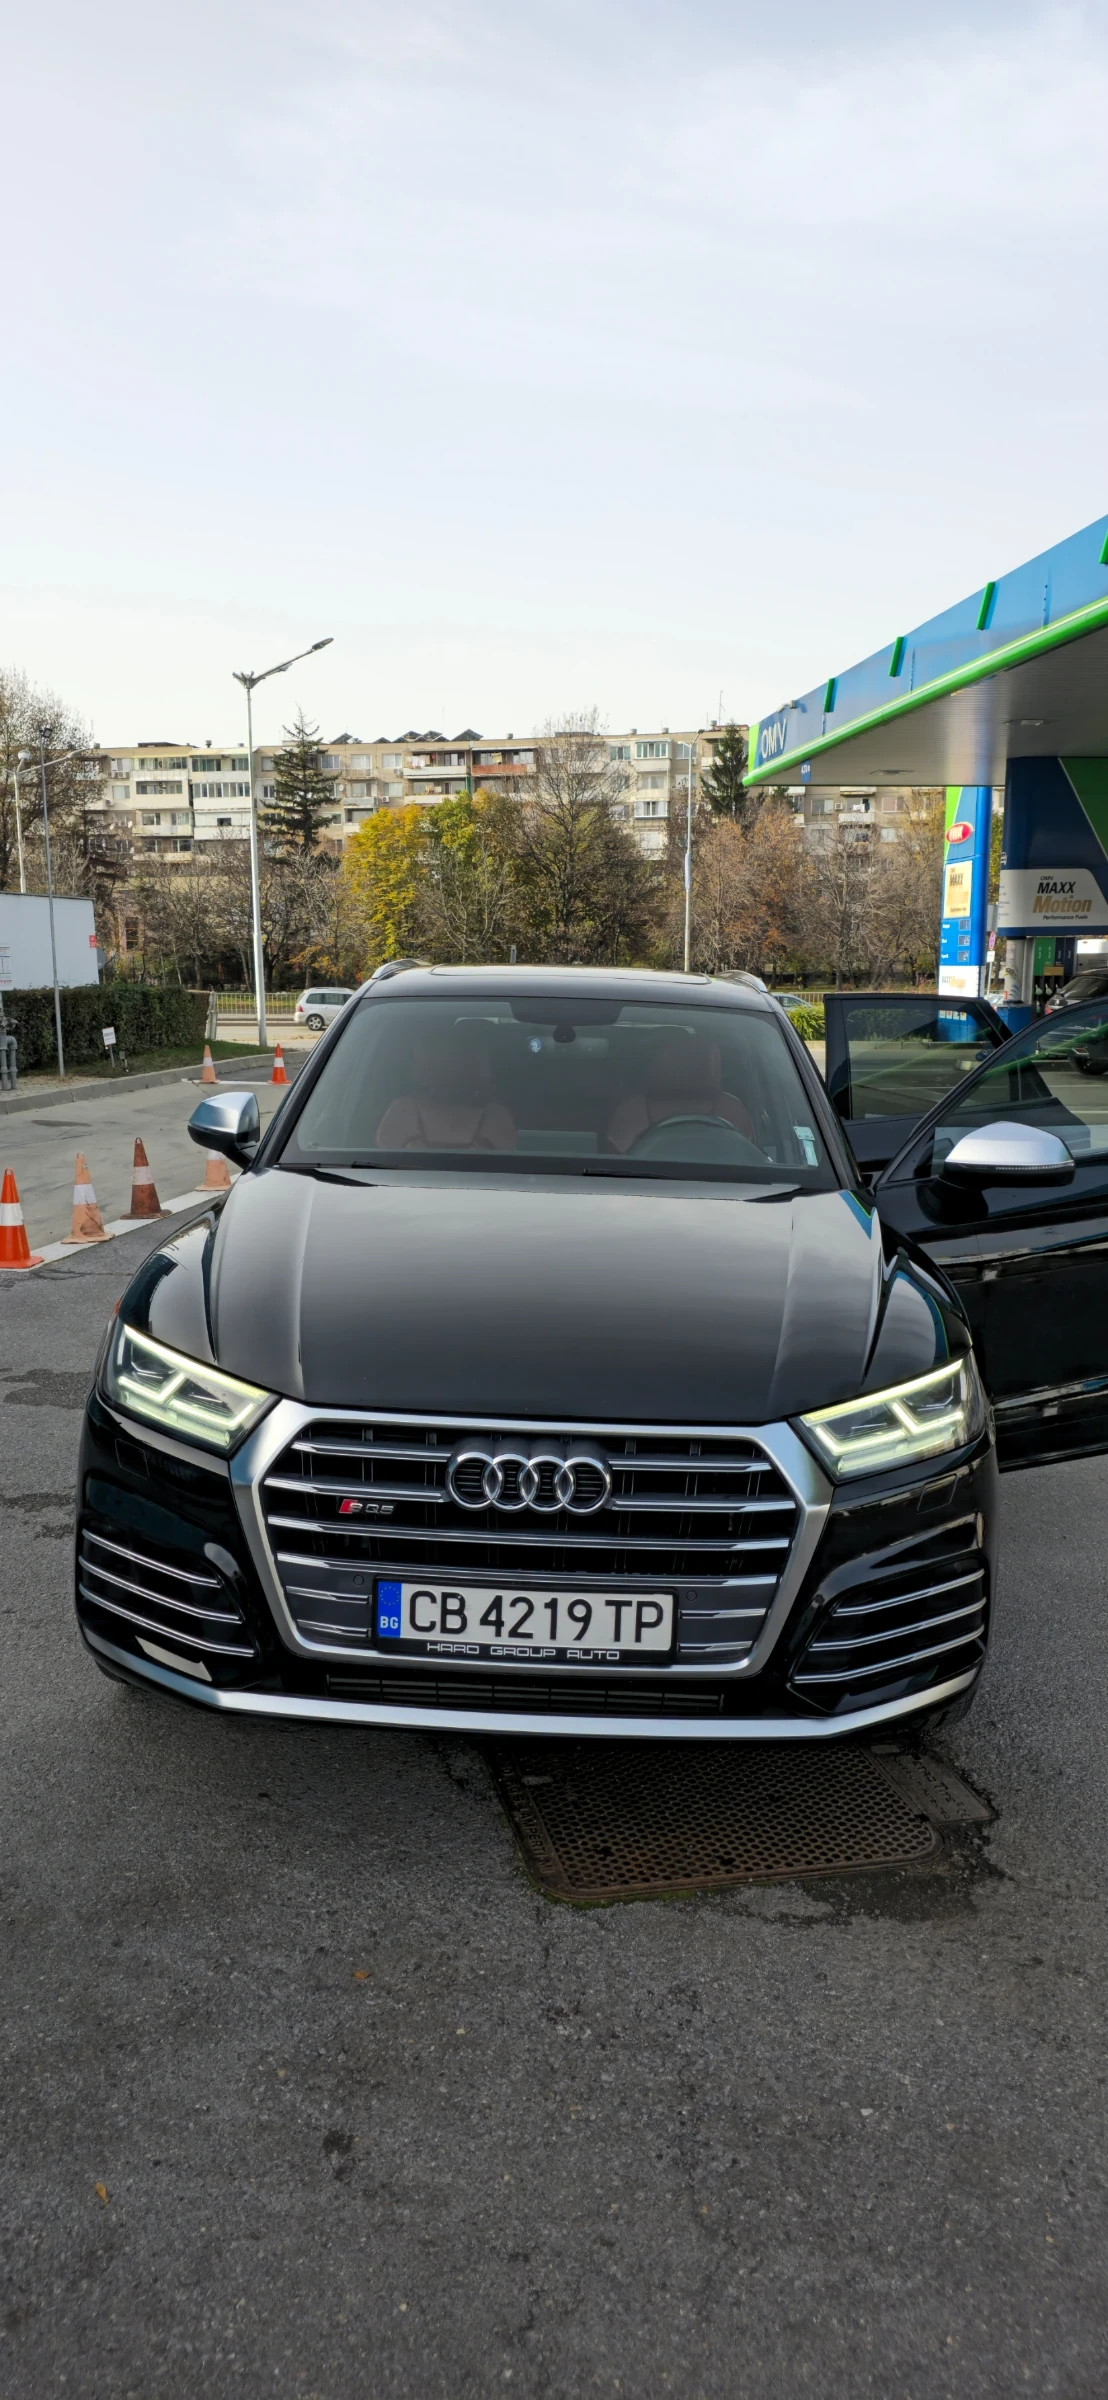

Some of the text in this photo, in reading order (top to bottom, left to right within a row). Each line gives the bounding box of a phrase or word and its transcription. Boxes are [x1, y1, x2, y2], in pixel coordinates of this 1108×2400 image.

[761, 717, 787, 758] OMV
[1037, 881, 1076, 894] MAXX
[1032, 895, 1092, 913] Motion
[347, 1502, 394, 1514] SQ5
[379, 1616, 399, 1629] BG
[409, 1590, 664, 1643] CB 4219 TP
[427, 1642, 620, 1660] HARD GROUP AUTO
